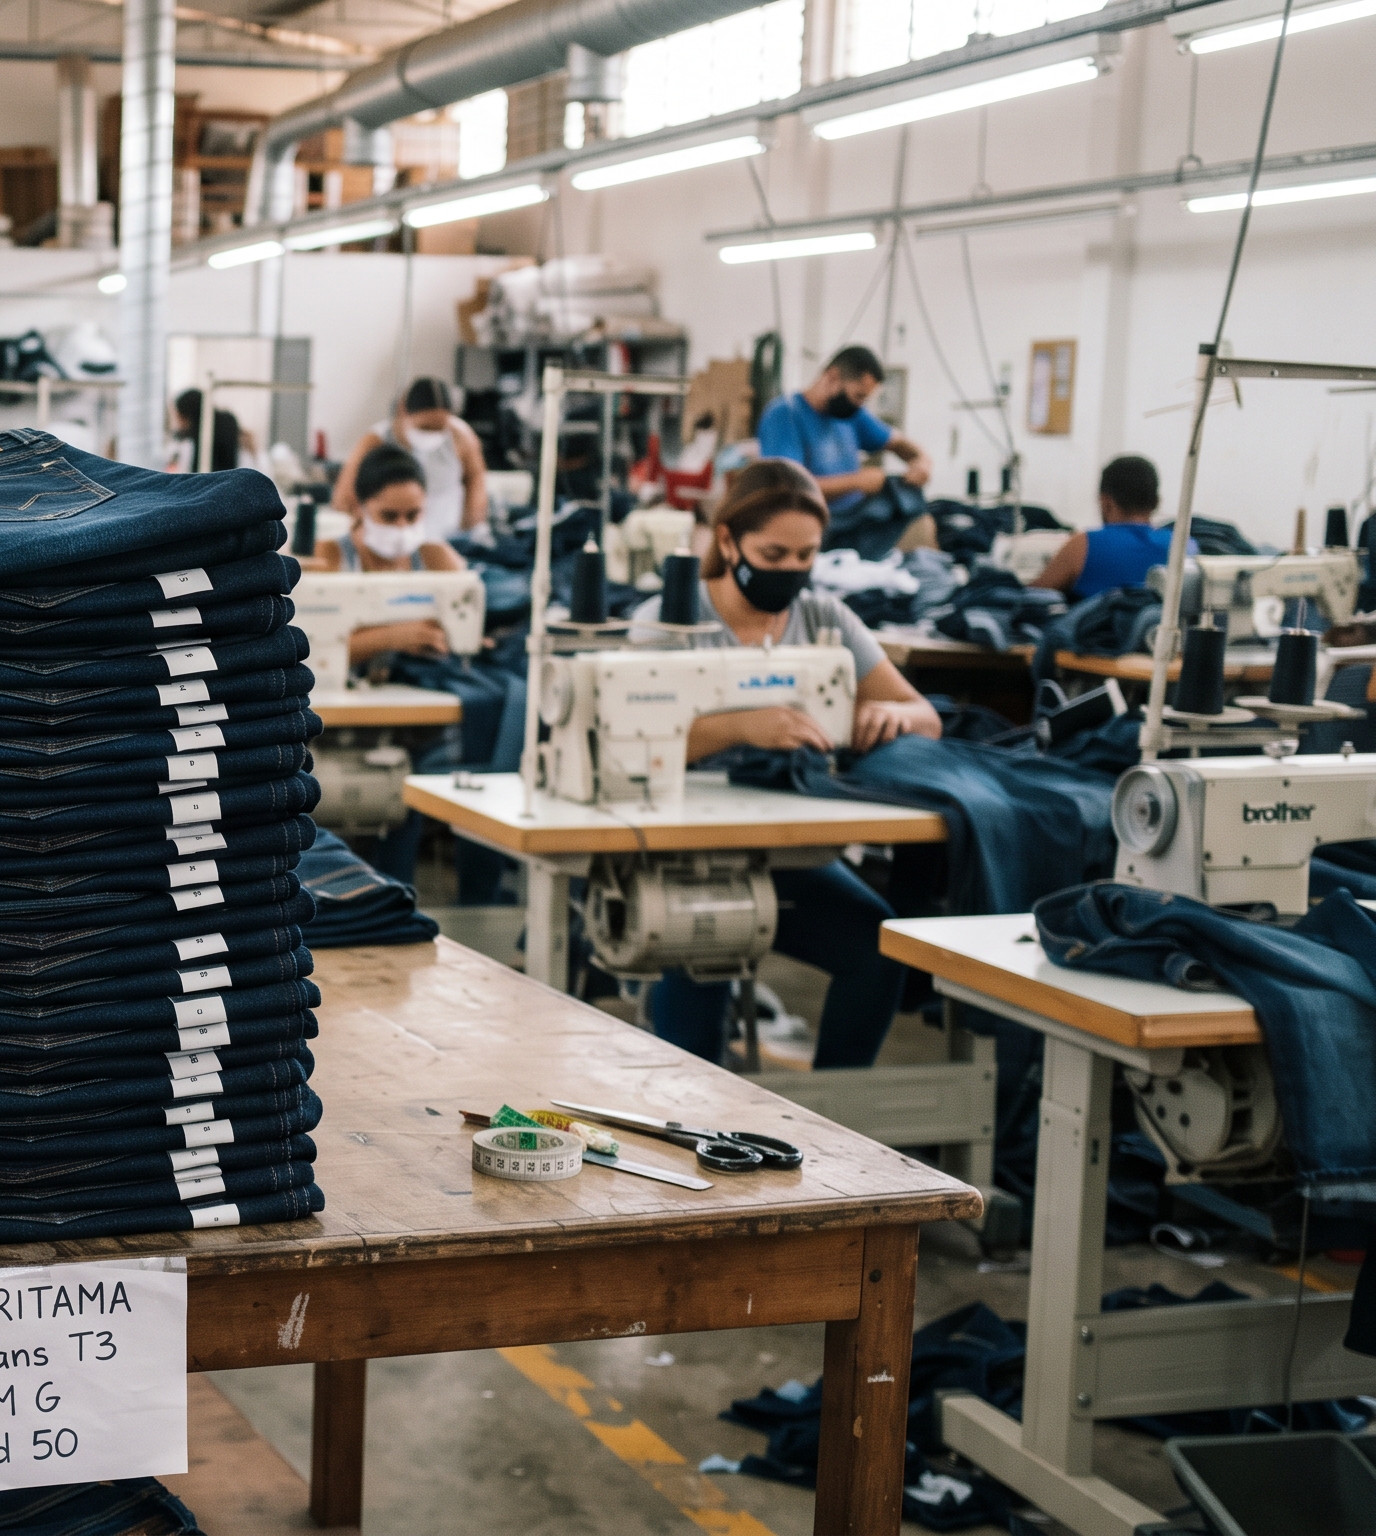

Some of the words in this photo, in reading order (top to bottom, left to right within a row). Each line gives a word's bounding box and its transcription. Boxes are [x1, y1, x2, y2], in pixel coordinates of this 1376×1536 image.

[68, 1331, 117, 1361] T3
[35, 1381, 61, 1412] G
[33, 1428, 78, 1460] 50
